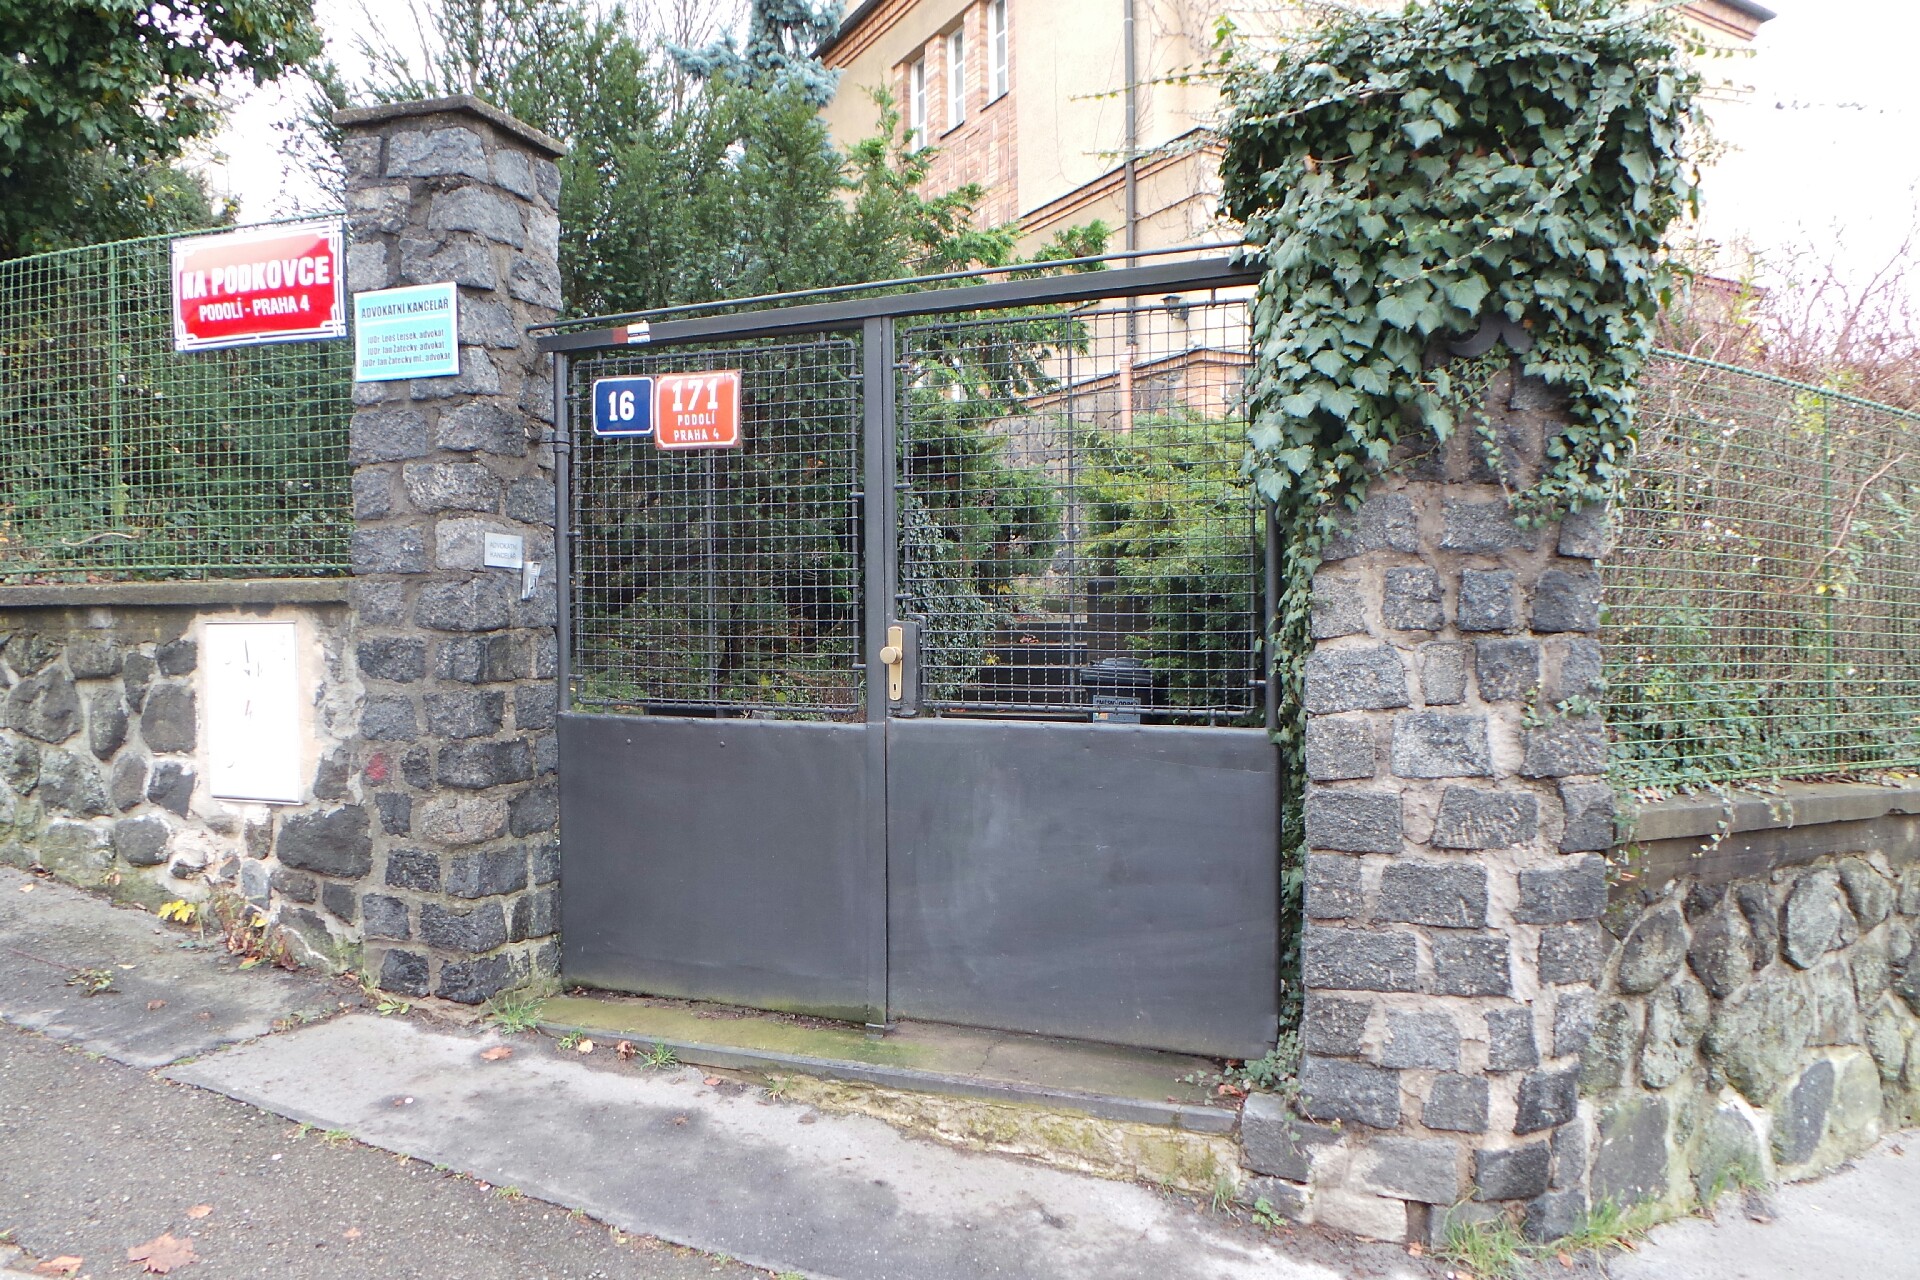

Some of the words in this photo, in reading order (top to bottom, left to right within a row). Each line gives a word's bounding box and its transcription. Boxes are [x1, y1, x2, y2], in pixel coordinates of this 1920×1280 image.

[182, 270, 207, 299] NA
[211, 256, 330, 296] PODKOVCE
[199, 297, 243, 322] PODOLÍ
[253, 296, 299, 317] PRAHA
[299, 294, 310, 312] 4
[406, 296, 449, 313] KANCELÁŘ
[608, 390, 635, 422] 16
[672, 378, 719, 412] 171
[677, 411, 715, 426] PODOLÍ
[673, 429, 709, 442] PRAHA
[712, 428, 720, 440] 4
